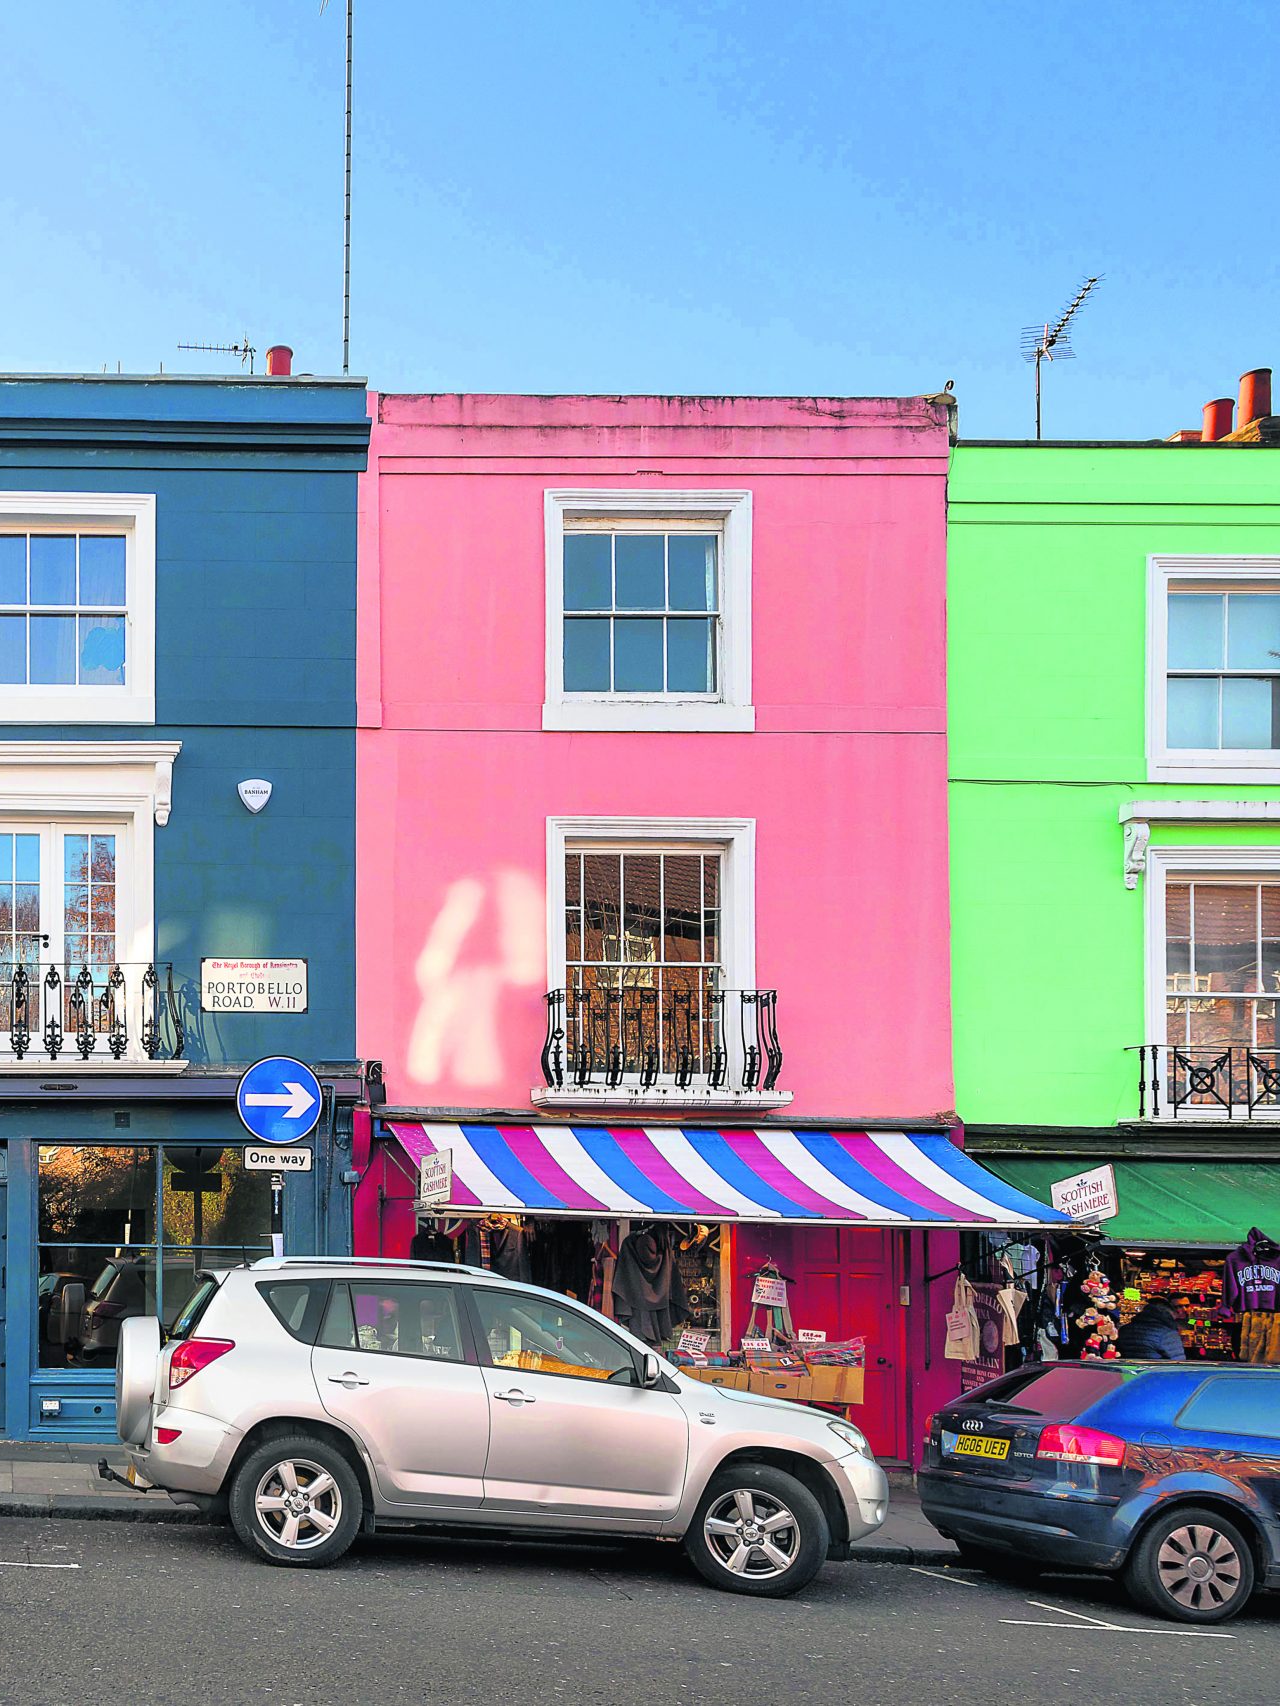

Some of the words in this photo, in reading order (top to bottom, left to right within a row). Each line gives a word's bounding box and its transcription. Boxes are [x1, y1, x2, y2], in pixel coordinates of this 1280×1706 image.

[240, 962, 261, 970] Borough
[207, 982, 303, 995] PORTOBELLO
[249, 1152, 276, 1163] One
[280, 1154, 306, 1166] way
[425, 1163, 447, 1179] SCOTTISH
[423, 1177, 448, 1193] CASHMERE
[1060, 1180, 1103, 1205] SCOTTISH
[956, 1437, 983, 1453] HG06
[984, 1441, 1007, 1456] UEB
